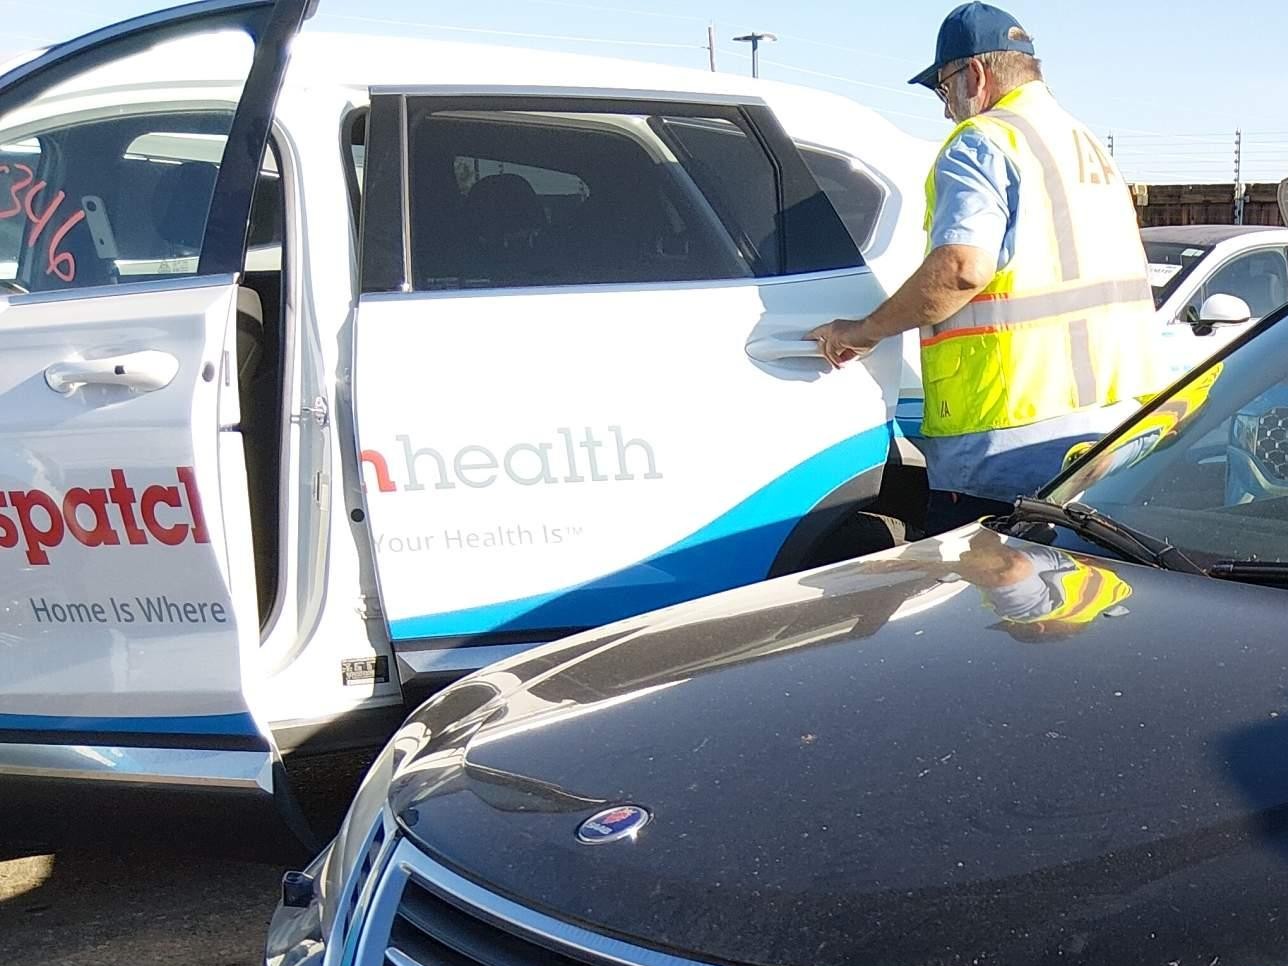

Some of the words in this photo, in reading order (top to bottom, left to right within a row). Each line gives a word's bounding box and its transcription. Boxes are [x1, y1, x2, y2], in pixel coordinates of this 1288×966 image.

[443, 524, 534, 549] Health
[30, 597, 107, 623] Home
[110, 597, 135, 623] Is
[136, 595, 227, 623] Where
